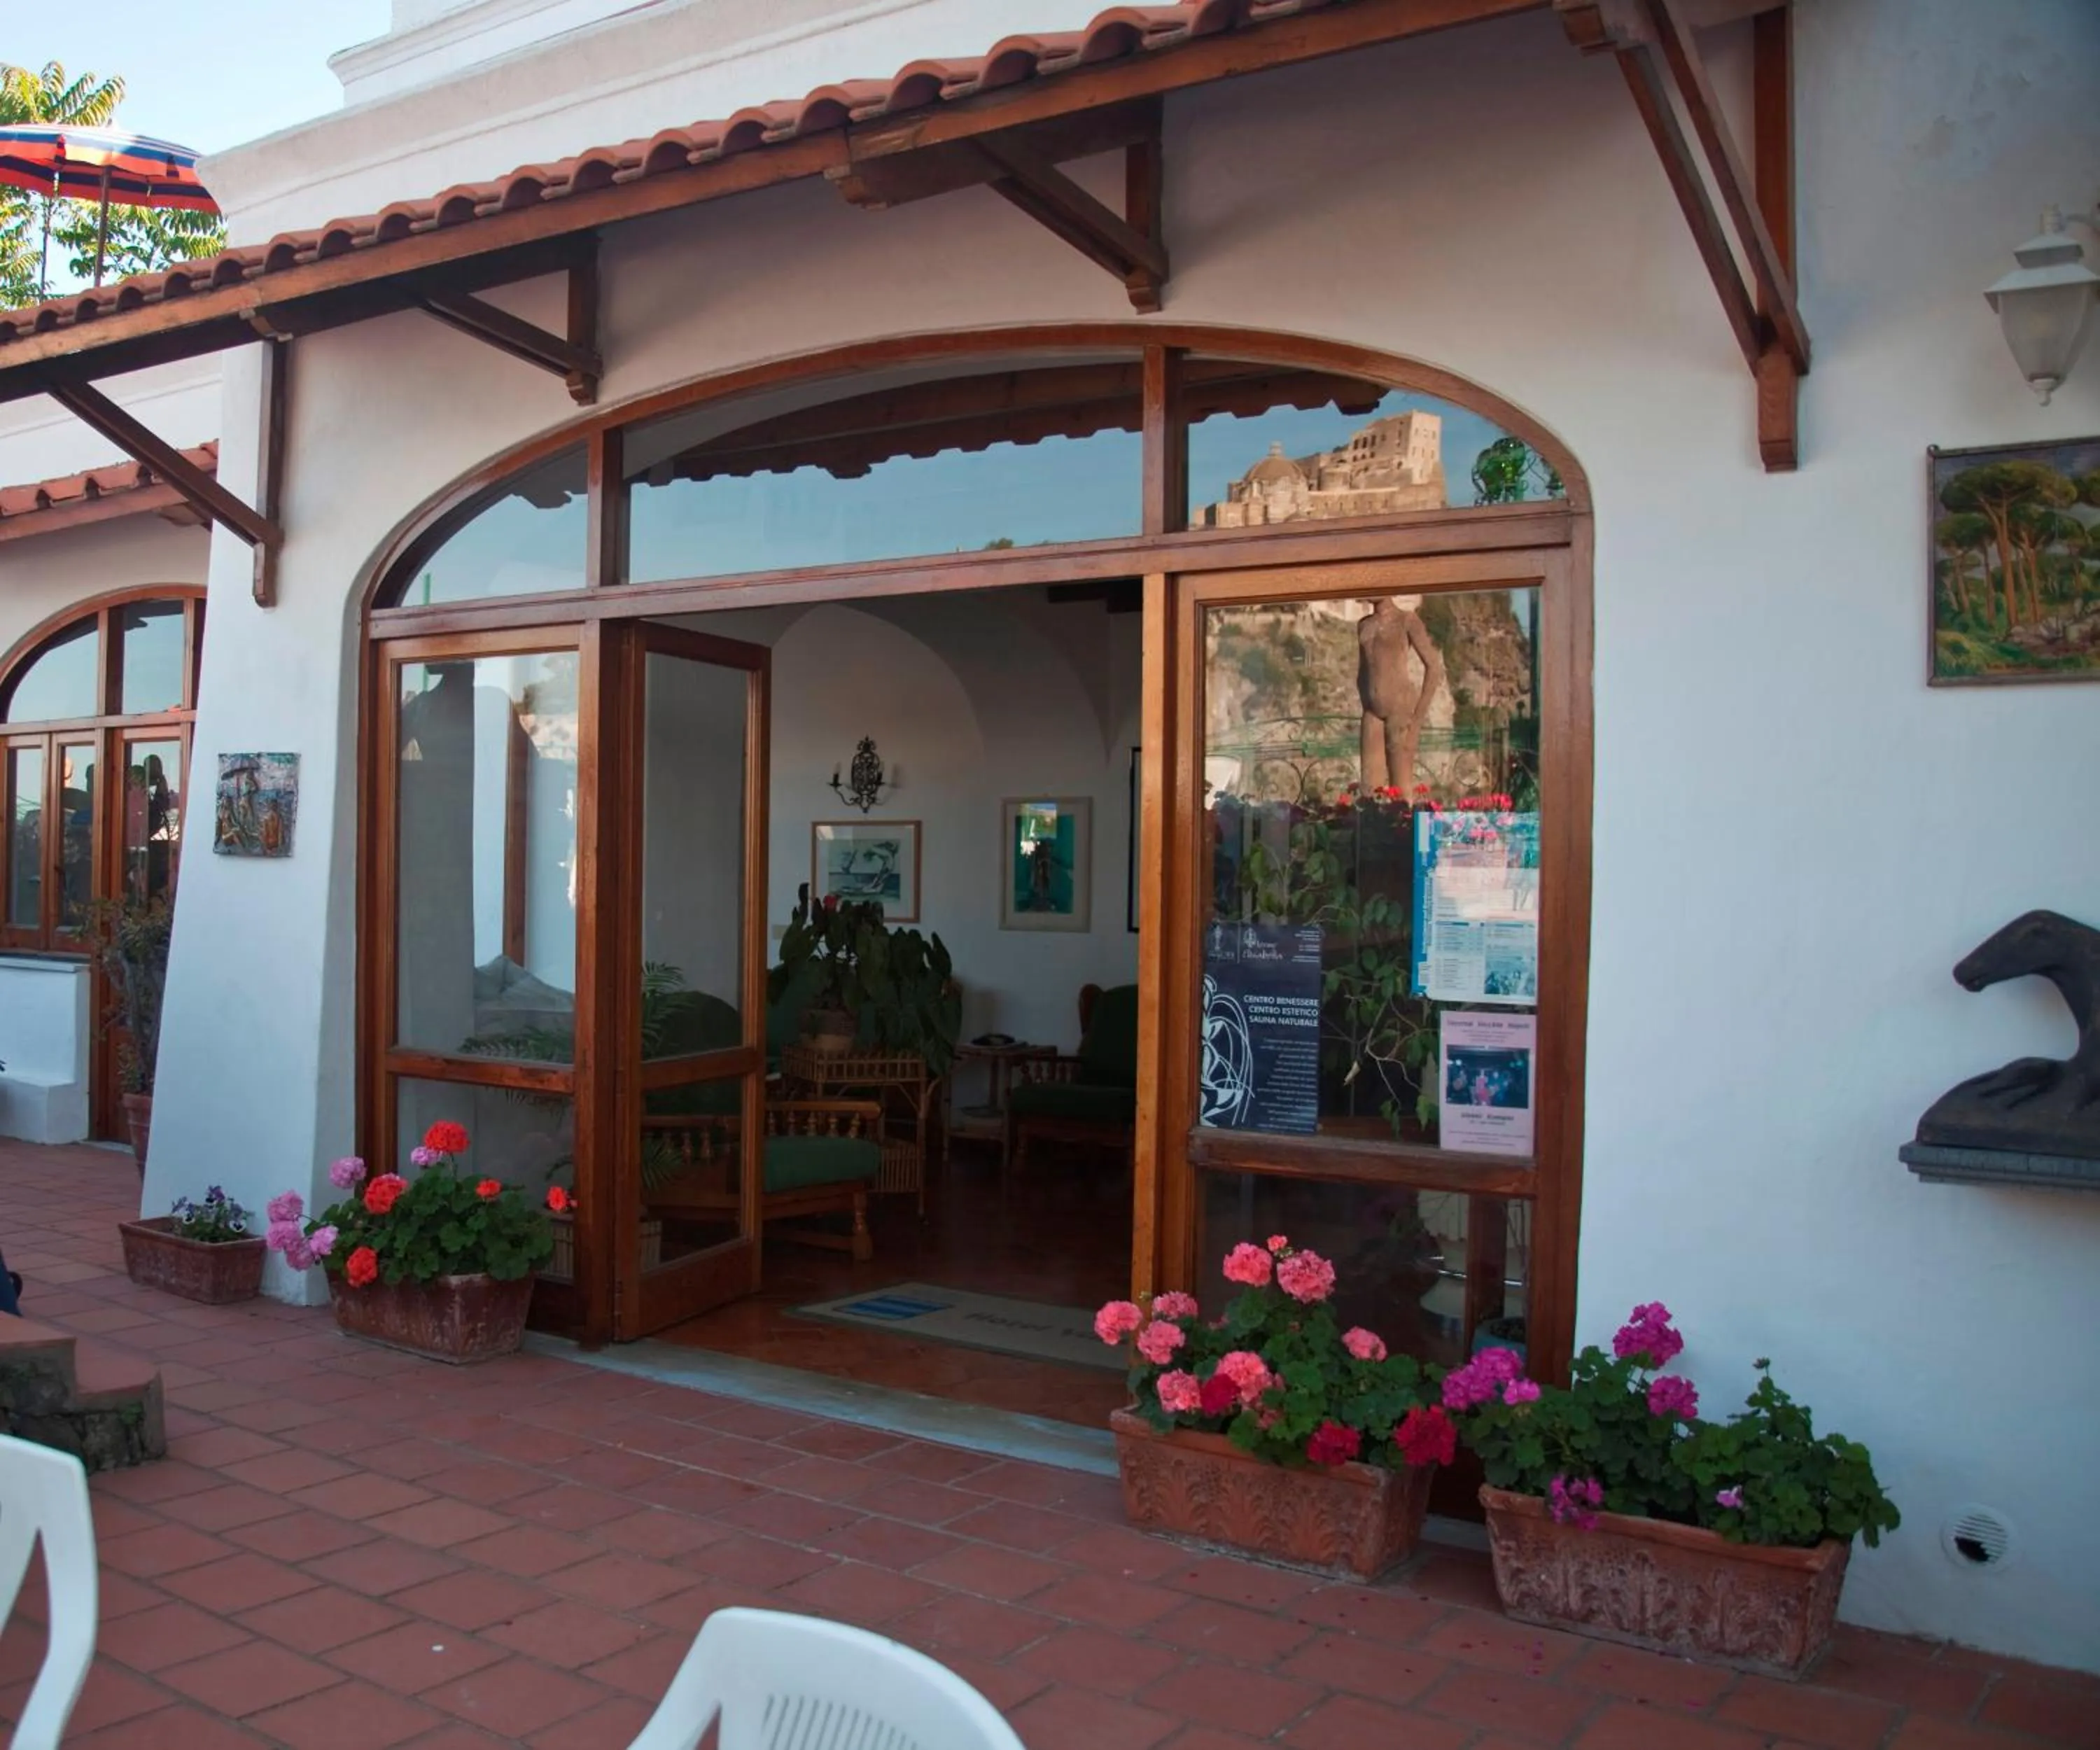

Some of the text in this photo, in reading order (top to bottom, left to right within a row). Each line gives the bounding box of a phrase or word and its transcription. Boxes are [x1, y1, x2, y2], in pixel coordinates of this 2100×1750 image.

[1243, 995, 1320, 1007] CENTRO BENESSERE
[1249, 1005, 1318, 1016] CENTRO ESTETICO
[1249, 1015, 1319, 1027] SAUNA NATURALE
